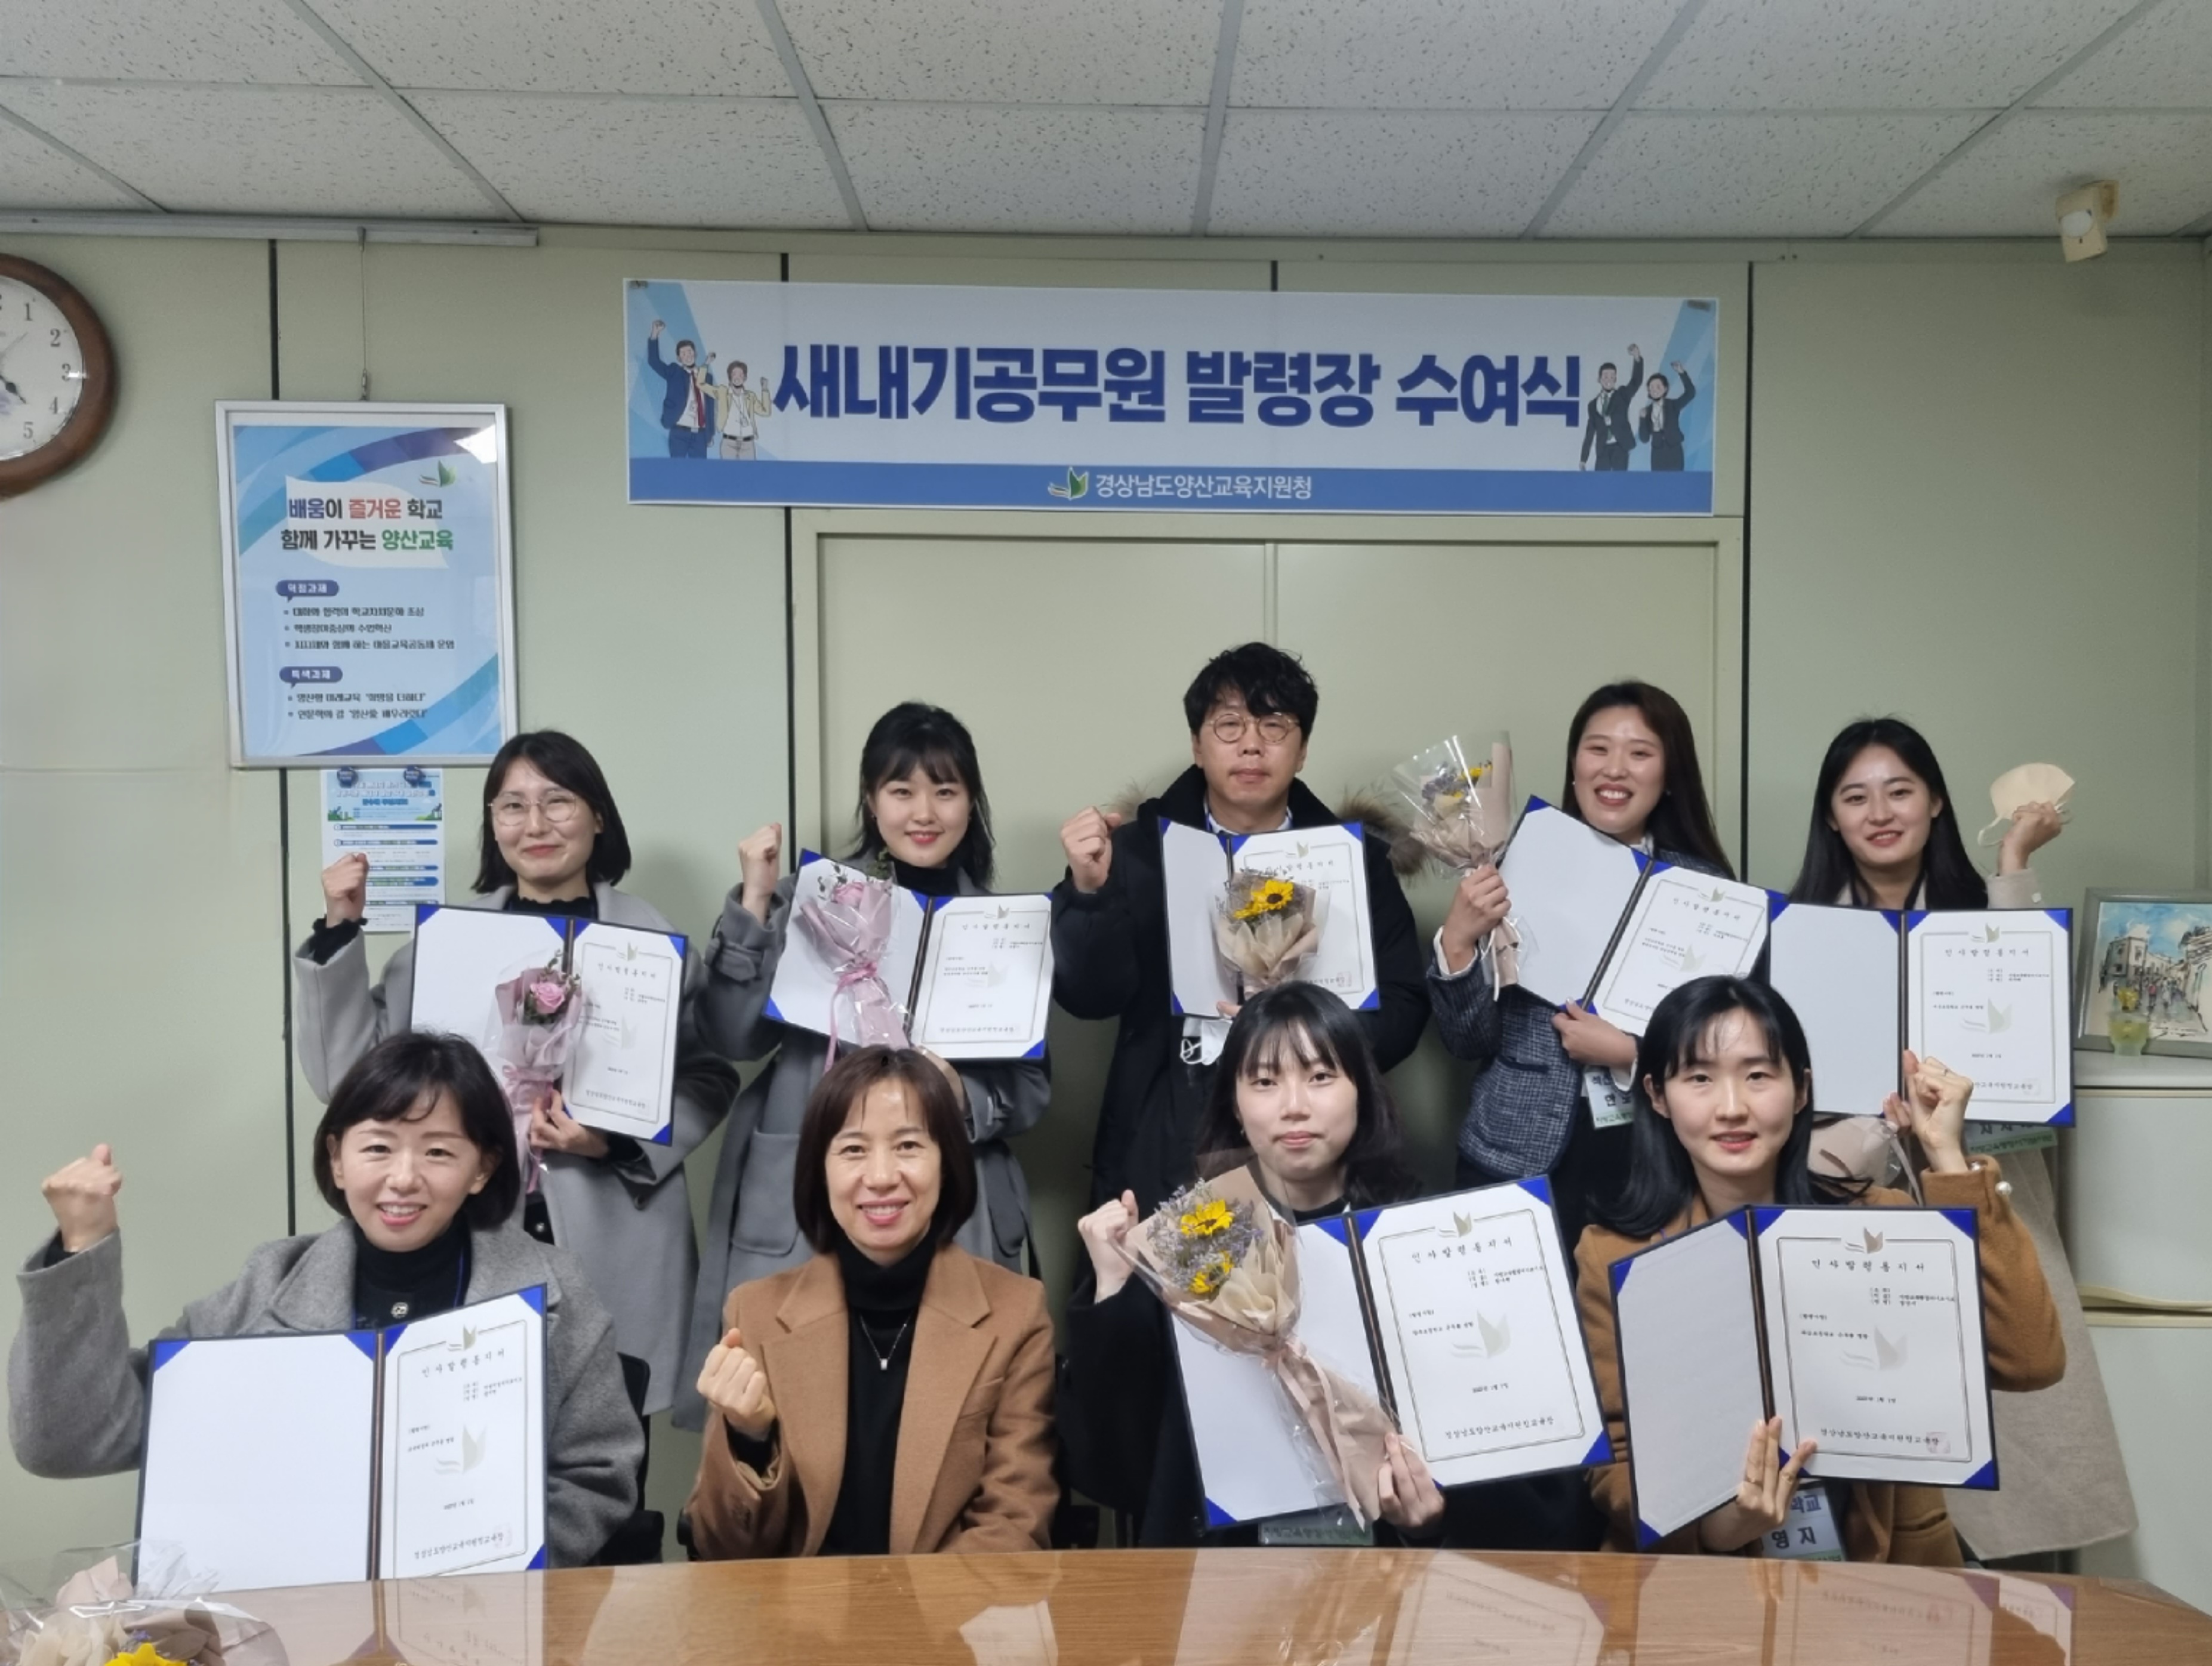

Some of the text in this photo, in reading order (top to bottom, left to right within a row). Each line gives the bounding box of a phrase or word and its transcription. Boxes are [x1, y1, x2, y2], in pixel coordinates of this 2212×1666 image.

[24, 303, 33, 321] 1
[50, 329, 61, 347] 2
[61, 363, 72, 381] 3
[773, 343, 1581, 428] 새내기공무원 발령장 수여식
[49, 397, 58, 414] 4
[23, 421, 33, 439] 5
[1095, 473, 1312, 500] 경상남도양산교육지원청
[288, 498, 443, 519] 배움이 즐거운 학교
[281, 529, 454, 551] 함께 가꾸는 양산교육
